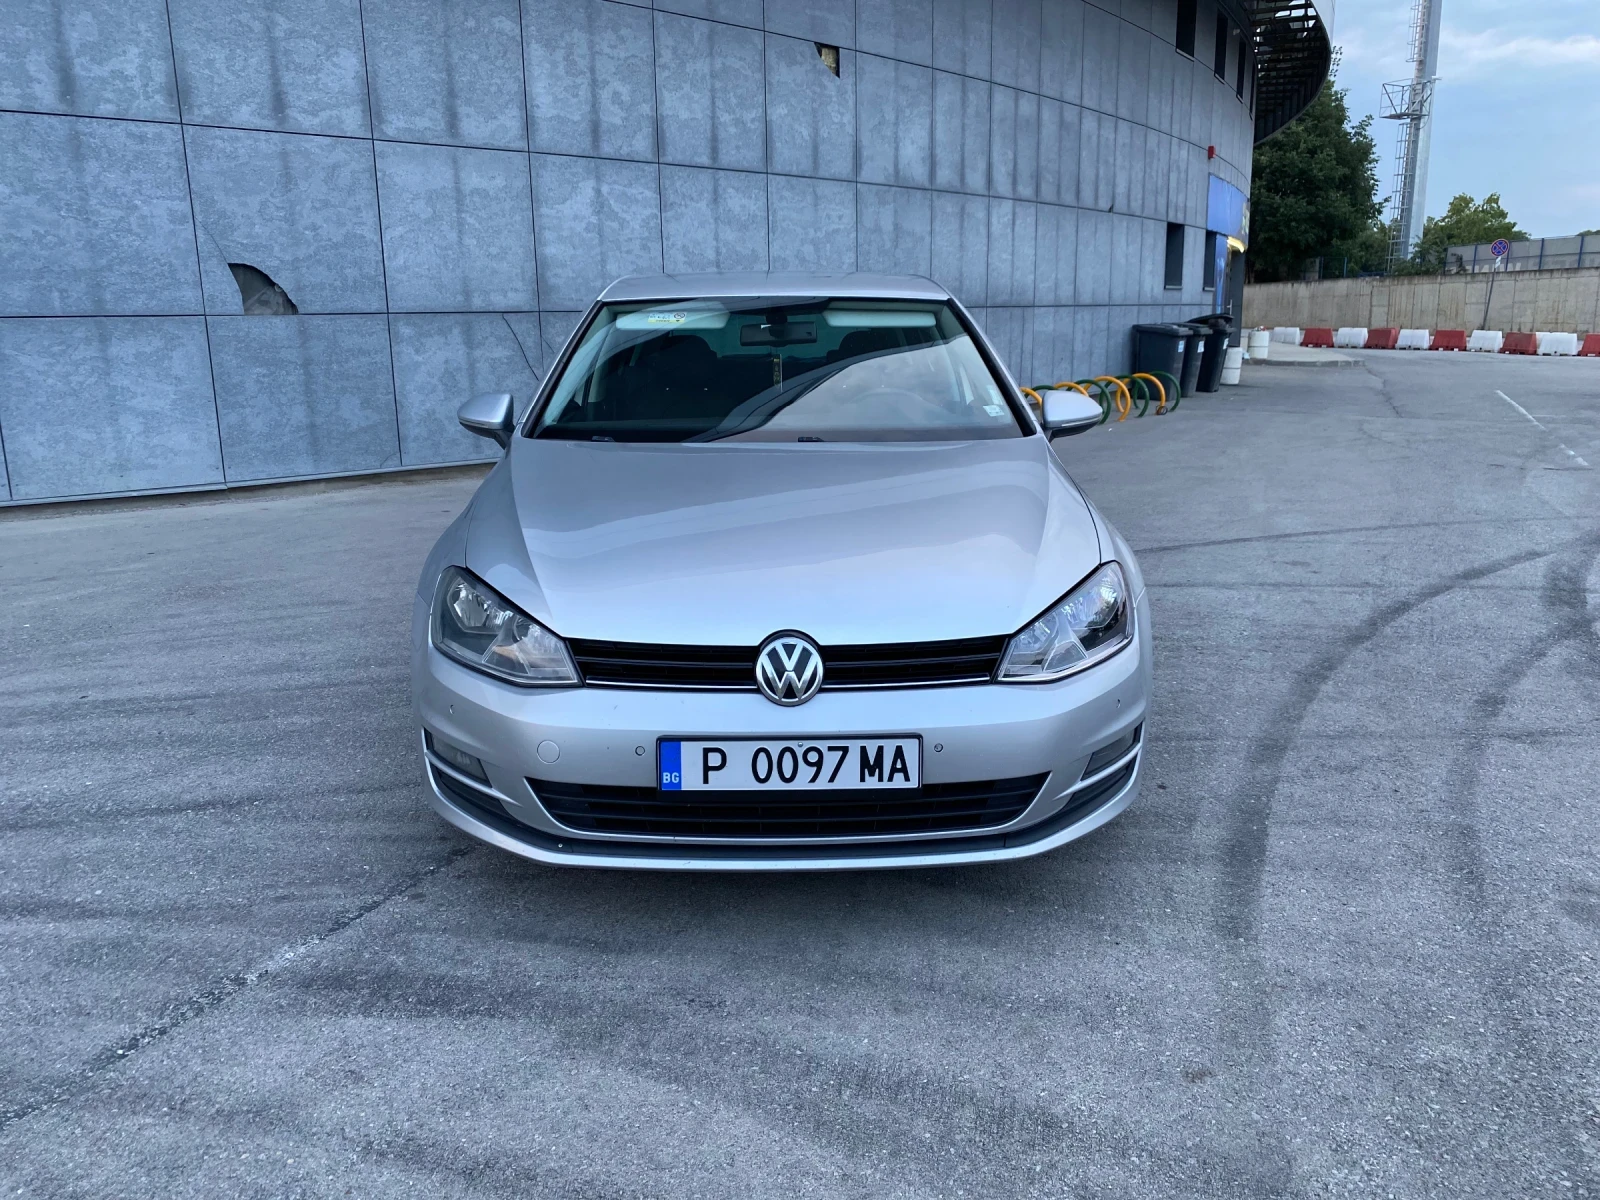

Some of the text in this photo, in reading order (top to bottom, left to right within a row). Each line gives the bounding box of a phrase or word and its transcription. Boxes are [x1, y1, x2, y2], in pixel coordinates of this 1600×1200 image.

[757, 637, 823, 706] VW
[662, 772, 680, 784] BG
[702, 745, 911, 784] P 0097 MA
